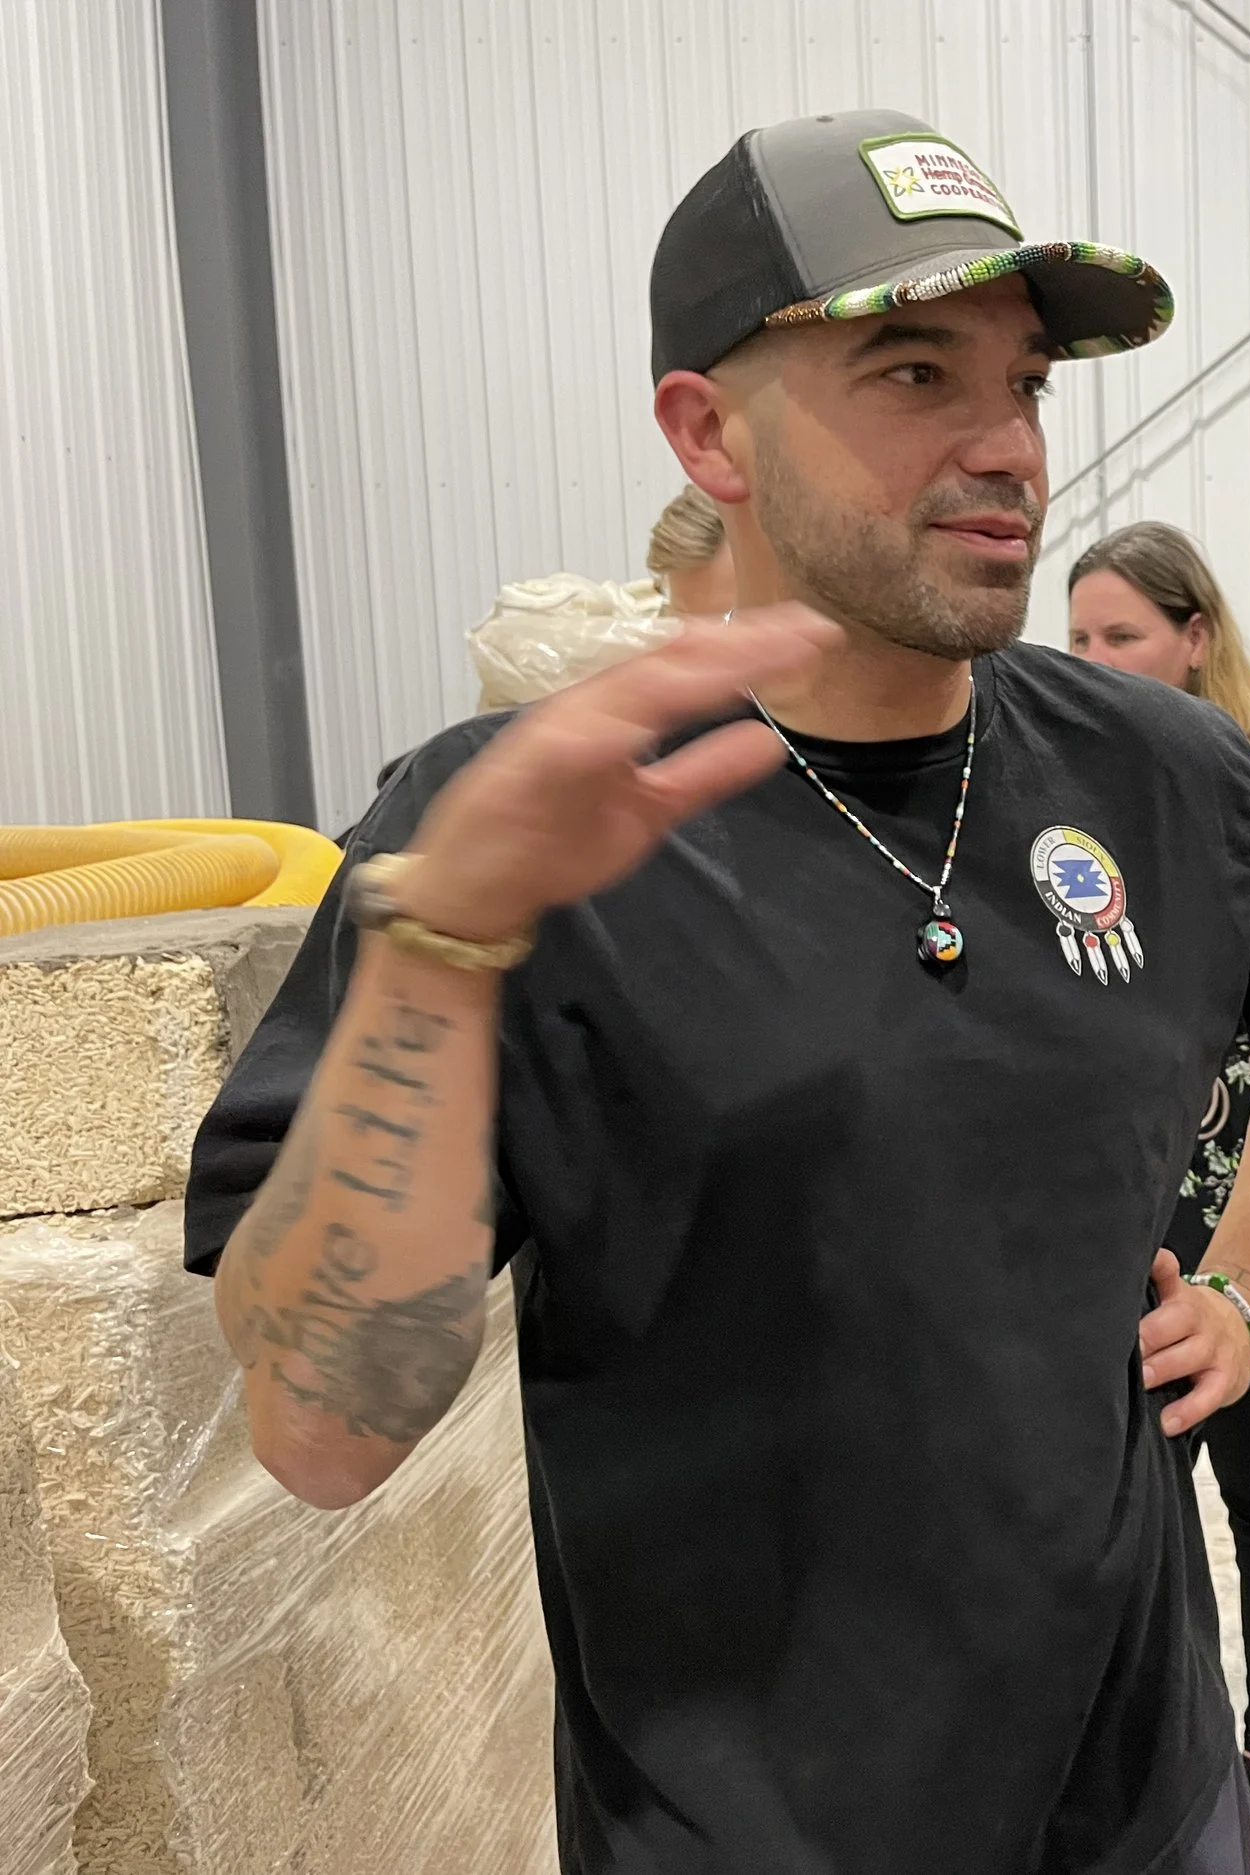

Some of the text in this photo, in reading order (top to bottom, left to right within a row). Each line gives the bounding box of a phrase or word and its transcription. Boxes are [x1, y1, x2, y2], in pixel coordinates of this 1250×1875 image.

[921, 168, 963, 184] Hemp
[1037, 836, 1105, 869] LOWER SIOUX
[1045, 891, 1082, 924] INDIAN
